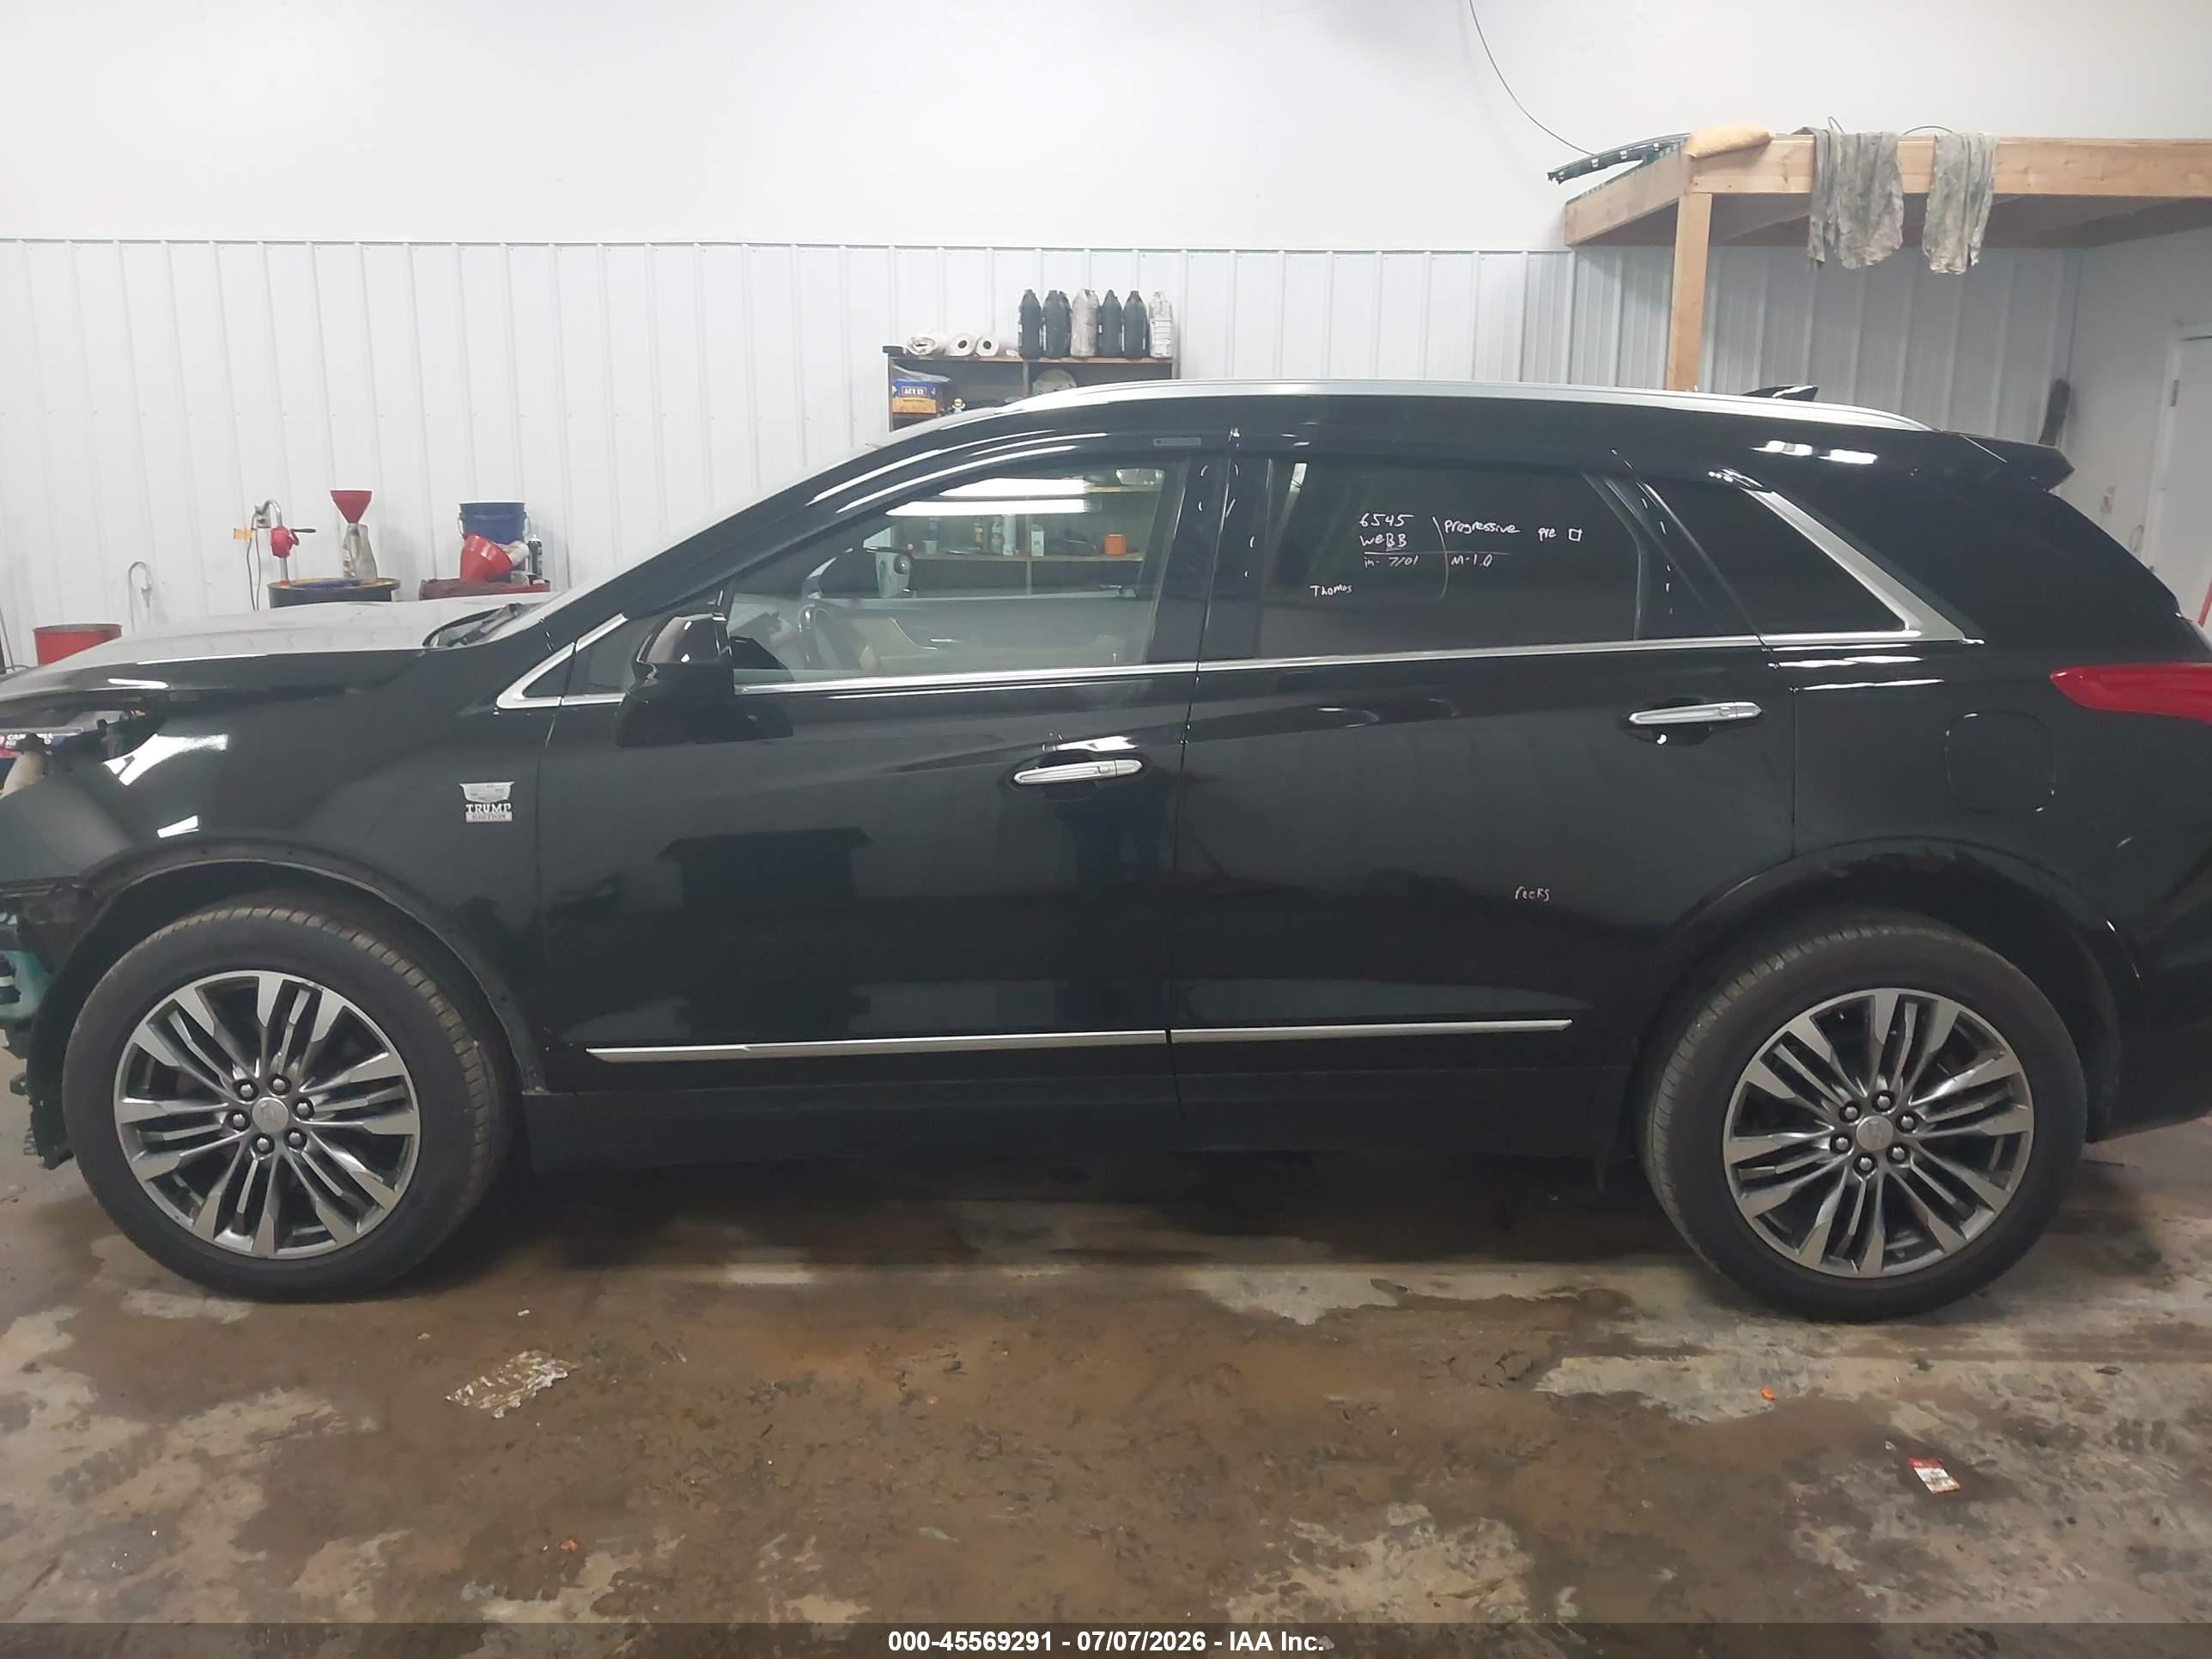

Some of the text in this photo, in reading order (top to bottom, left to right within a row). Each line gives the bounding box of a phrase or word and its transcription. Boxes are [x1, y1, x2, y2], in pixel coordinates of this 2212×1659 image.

[1359, 513, 1415, 526] 6545
[1310, 584, 1352, 597] Thomas
[465, 803, 512, 813] TRUMP
